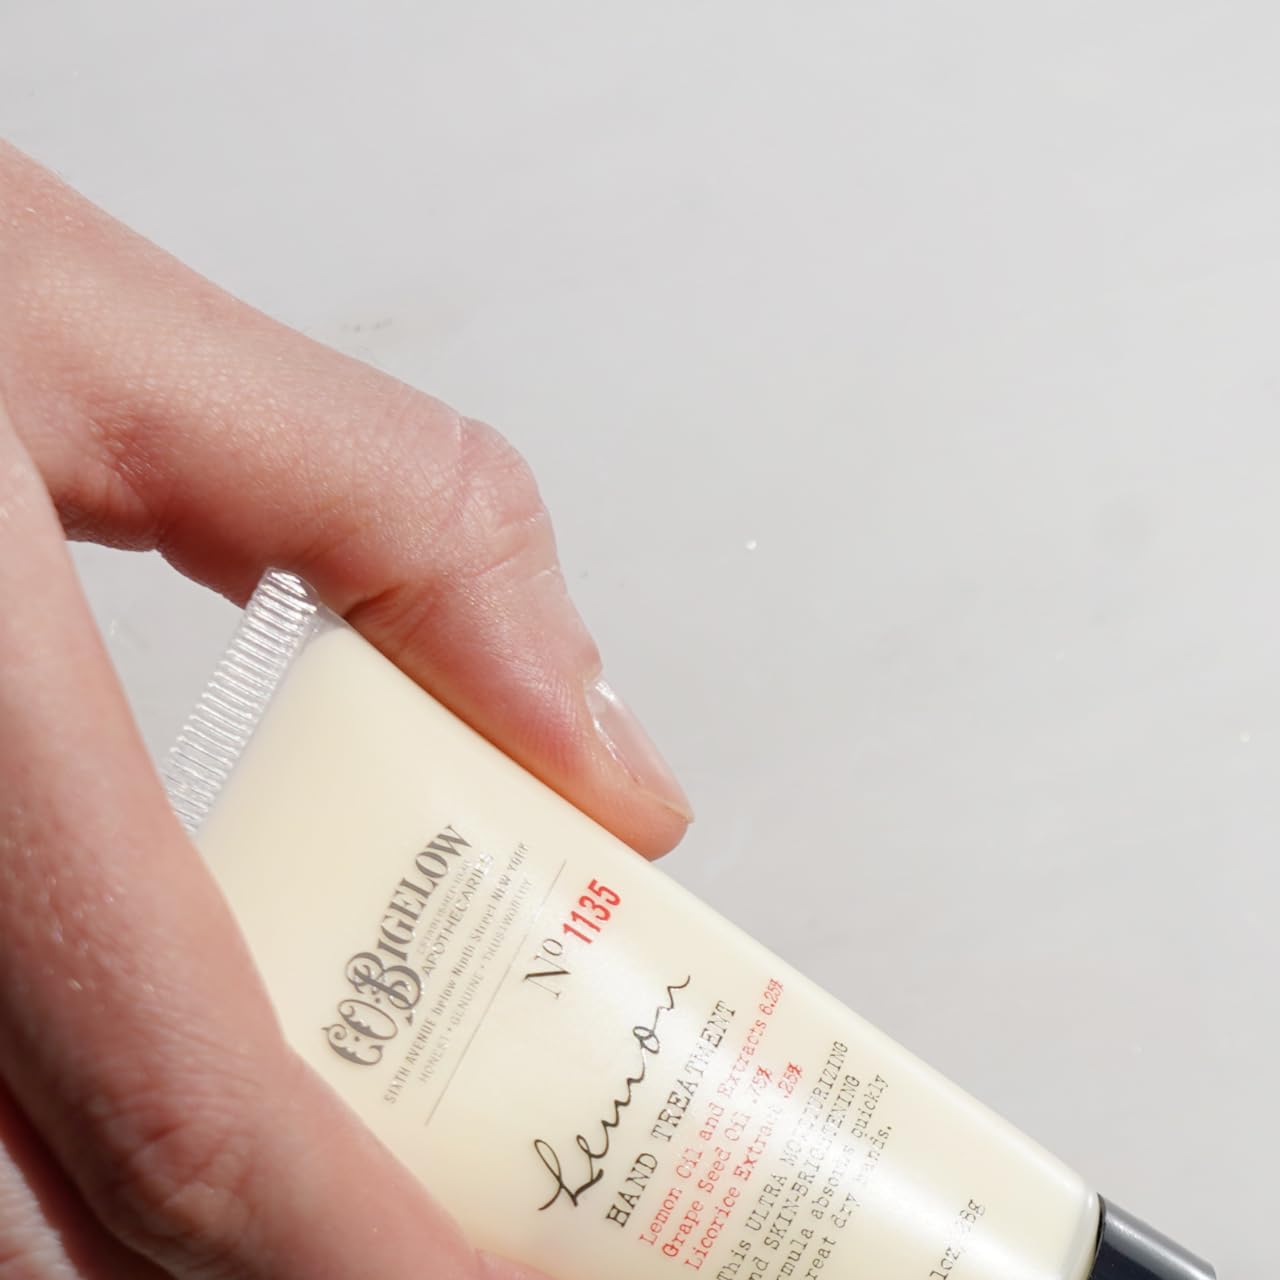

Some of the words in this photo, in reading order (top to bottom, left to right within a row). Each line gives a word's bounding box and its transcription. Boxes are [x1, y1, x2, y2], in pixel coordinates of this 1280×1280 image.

[382, 1066, 411, 1105] SIXTH
[404, 1019, 437, 1065] AVENUE
[431, 979, 457, 1016] below
[450, 944, 476, 977] Ninth
[469, 903, 497, 943] Street
[490, 874, 512, 902] NEW
[562, 878, 621, 945] 1135
[534, 975, 691, 1211] Lemon
[604, 1152, 659, 1229] HAND
[649, 999, 737, 1143] TREATMENT
[638, 1187, 683, 1246] Lemon
[675, 1147, 704, 1179] Oil
[698, 1101, 725, 1142] and
[716, 1019, 767, 1099] Extracts
[757, 977, 784, 1016] 6.25%
[661, 1200, 704, 1258] Grape
[696, 1146, 732, 1194] Seed
[724, 1111, 752, 1142] Oil
[751, 1065, 773, 1105] .75%
[683, 1186, 741, 1272] Licorice
[732, 1108, 783, 1182] Extract
[777, 1061, 803, 1099] .25%
[830, 1192, 861, 1229] dry
[855, 1125, 893, 1186] ands.
[850, 1073, 889, 1139] quickly
[744, 1173, 788, 1232] ULTRA
